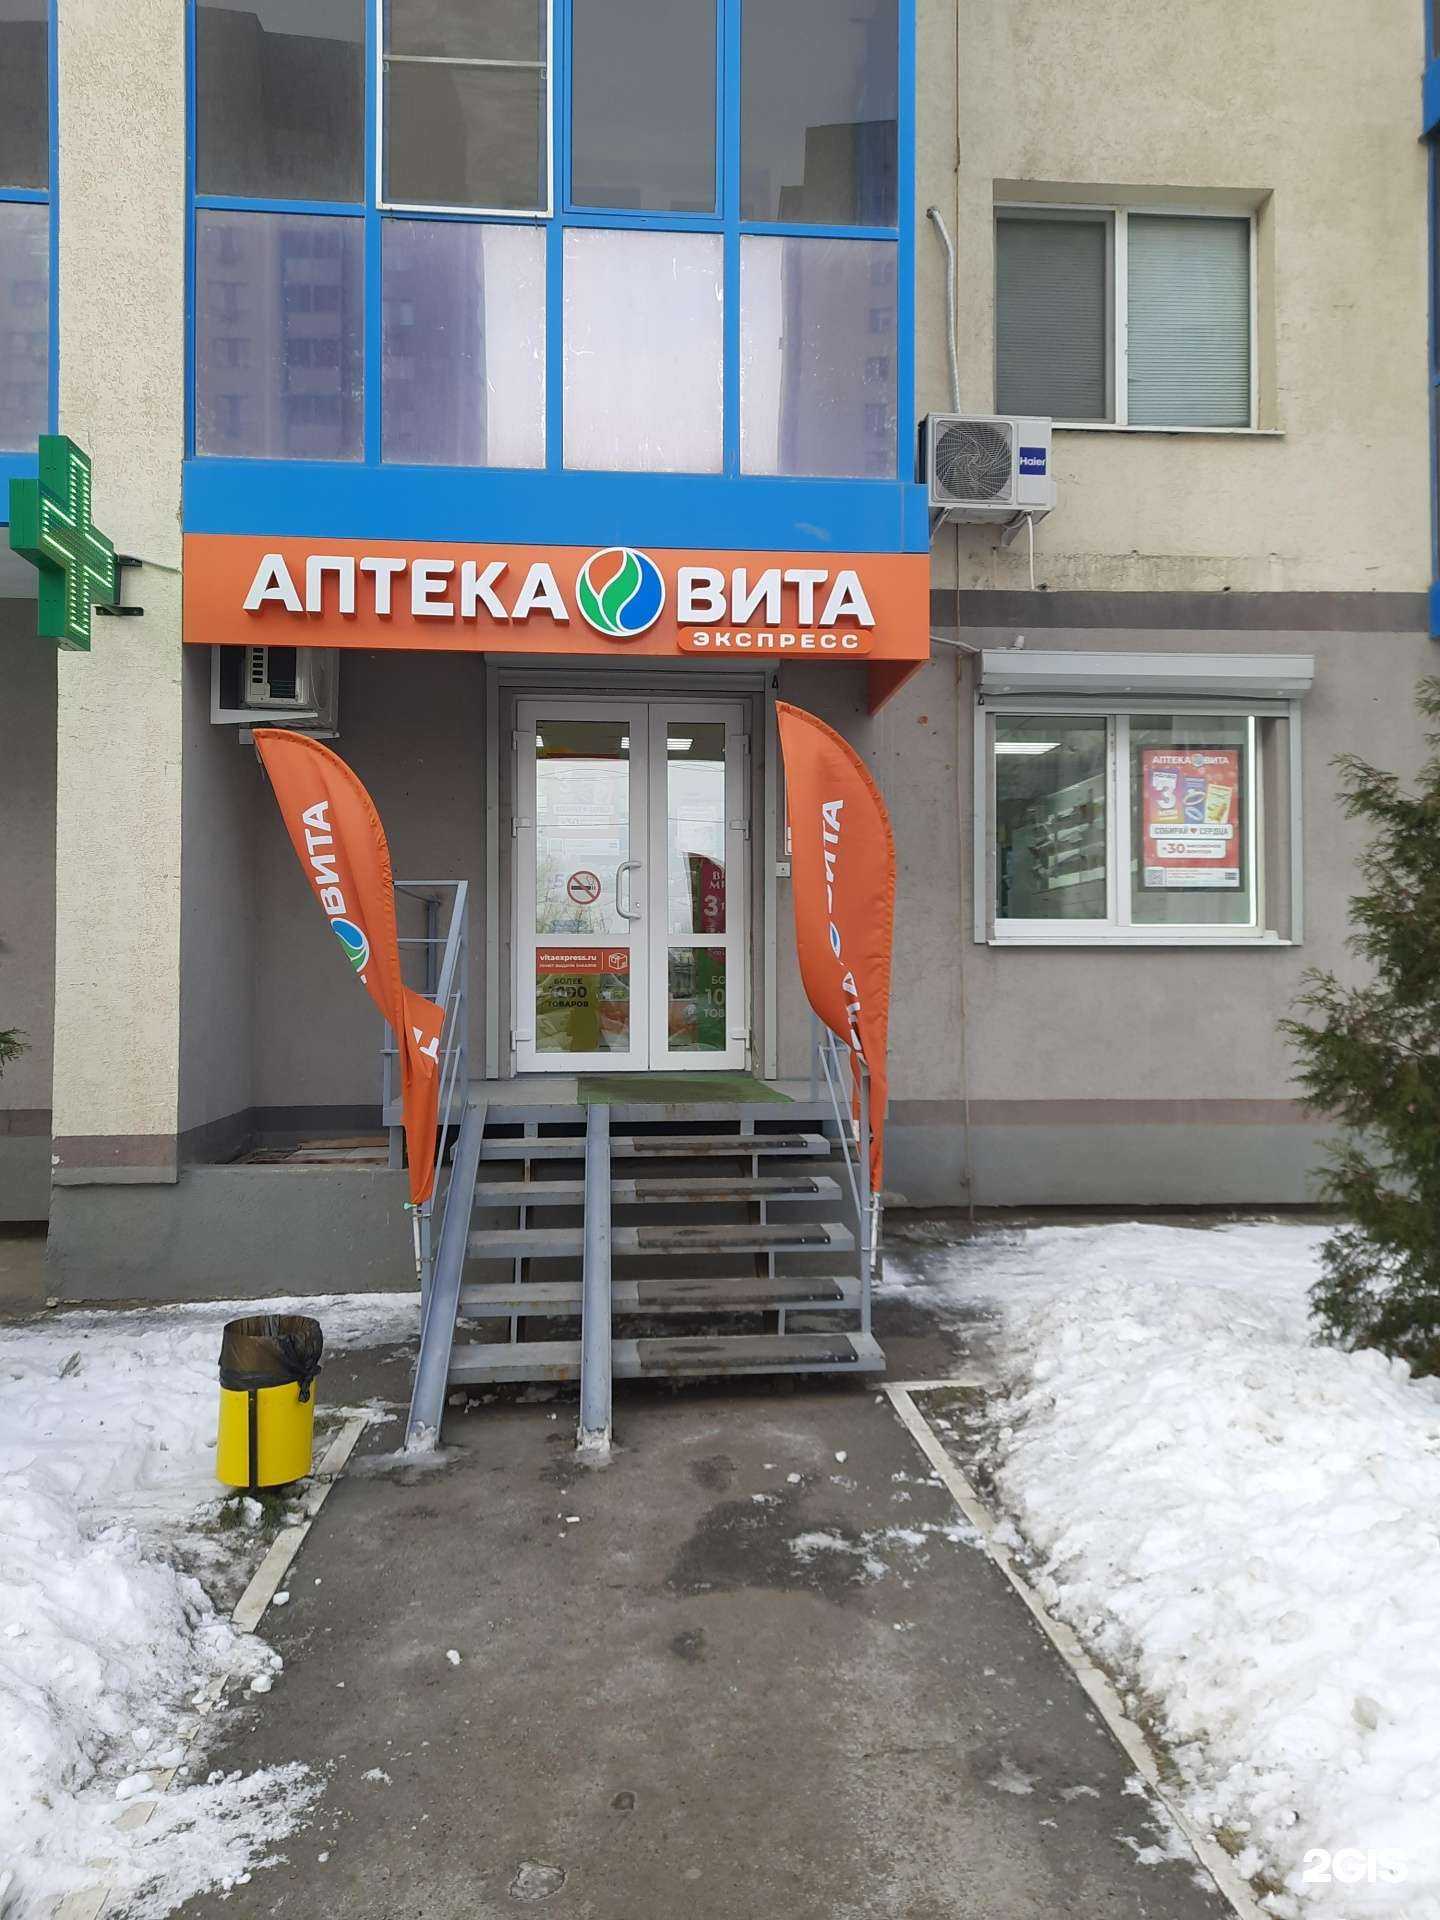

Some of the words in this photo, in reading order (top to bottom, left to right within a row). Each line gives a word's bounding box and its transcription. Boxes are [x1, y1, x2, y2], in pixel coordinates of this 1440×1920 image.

[1020, 456, 1046, 466] Haier
[243, 553, 570, 619] АПТЕКА
[677, 566, 875, 626] ВИТА
[692, 632, 860, 650] ЭКСПРЕСС
[1152, 756, 1191, 764] АПТЕКА
[1203, 756, 1229, 764] ВИТА
[302, 800, 345, 915] ВИТА
[540, 954, 597, 962] vitaexpress.ru
